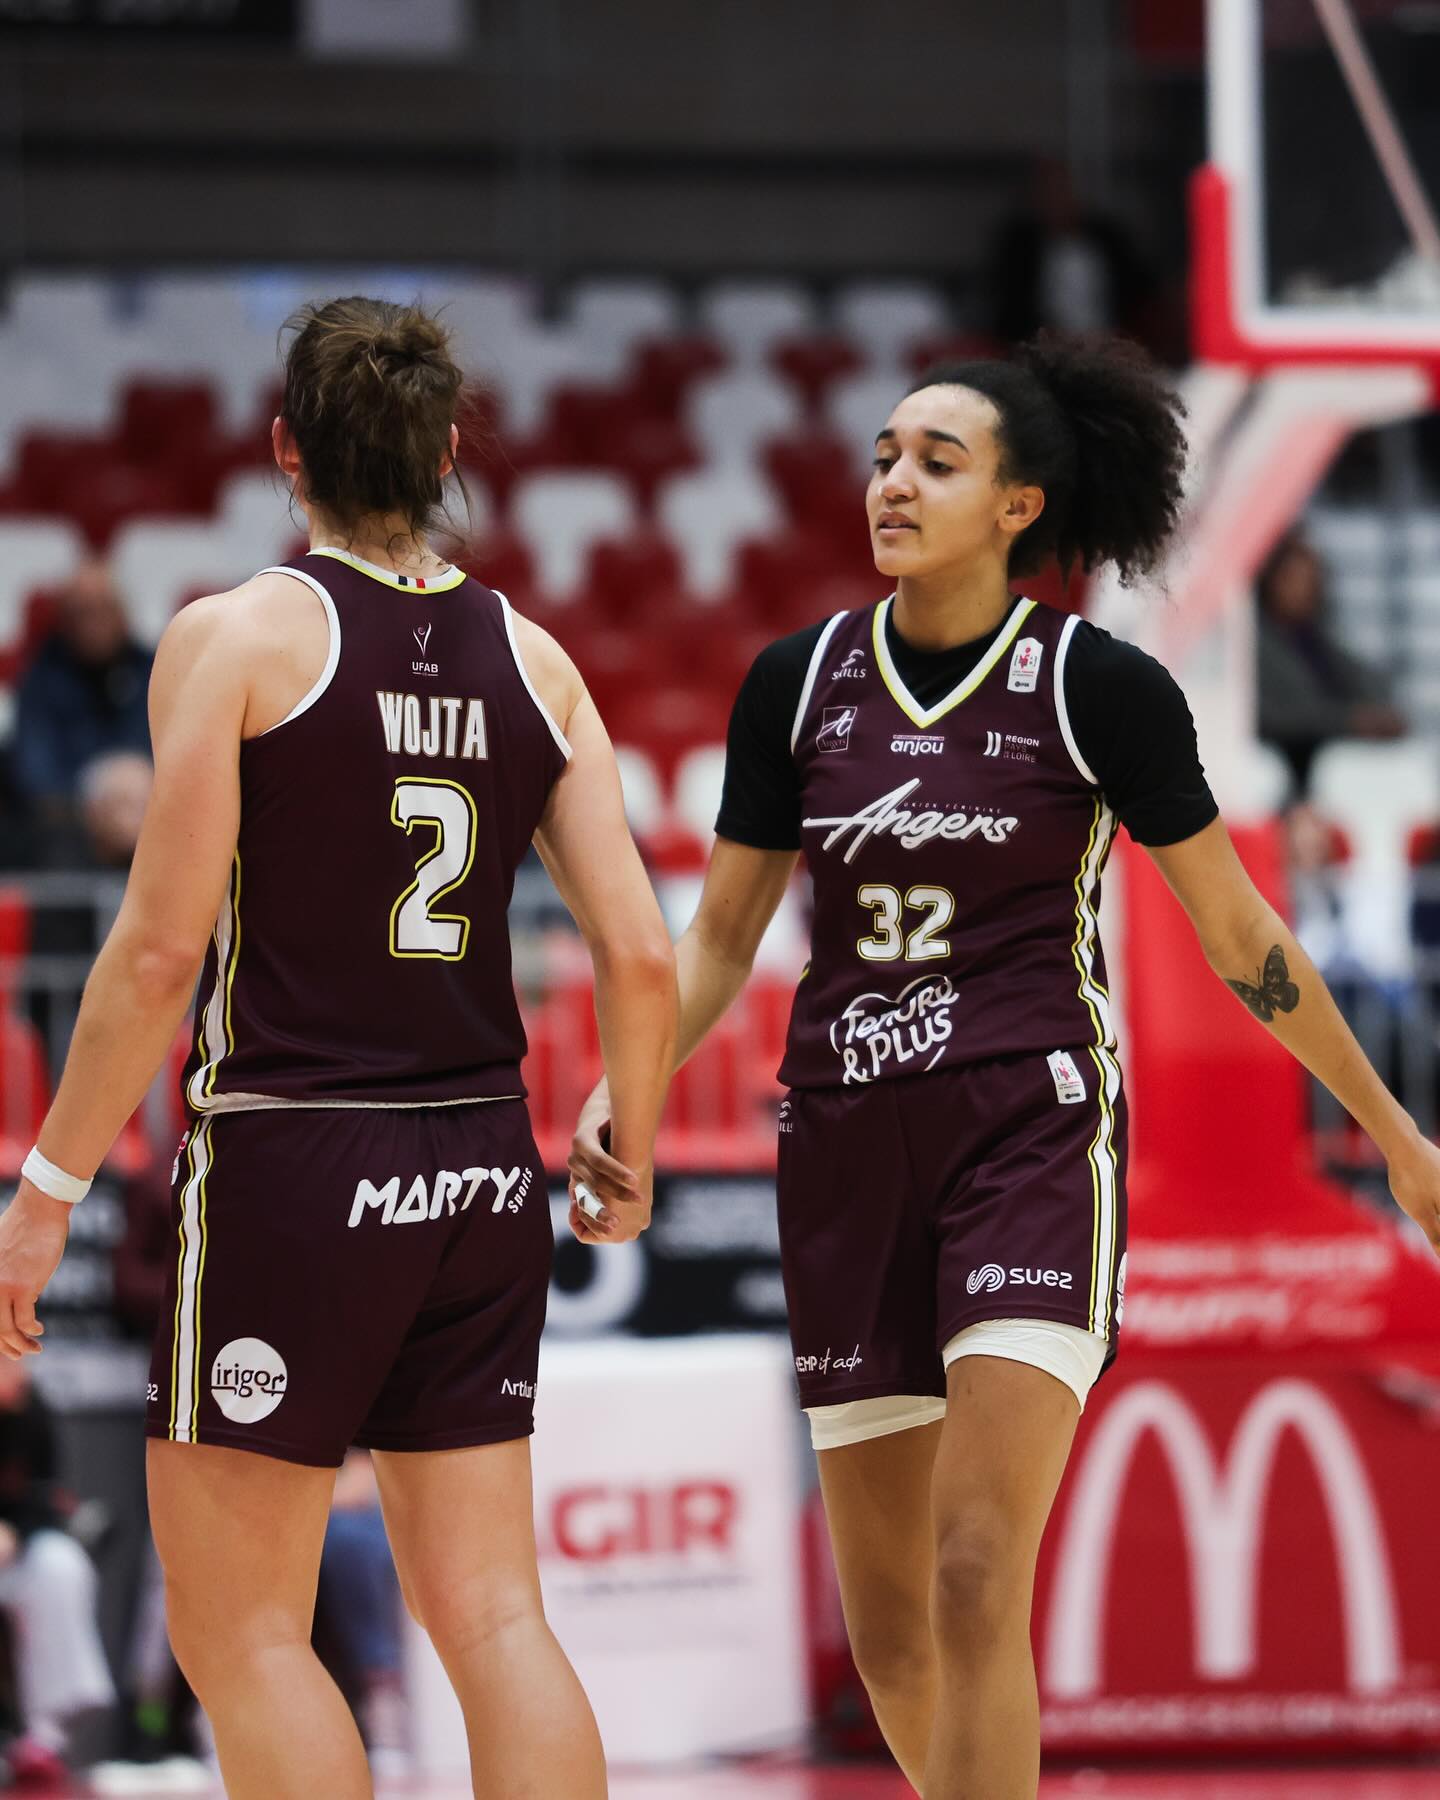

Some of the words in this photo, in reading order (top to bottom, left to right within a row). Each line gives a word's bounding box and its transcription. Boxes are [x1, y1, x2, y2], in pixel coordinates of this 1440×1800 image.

[411, 661, 440, 674] UFAB
[376, 690, 489, 761] WOJTA
[890, 738, 945, 756] anjou
[802, 777, 1021, 864] Angers
[389, 776, 478, 962] 2
[857, 884, 955, 961] 32
[866, 1008, 953, 1077] PLUS
[347, 1166, 521, 1229] MARTY
[1009, 1268, 1073, 1290] suez
[537, 1483, 739, 1560] GIR
